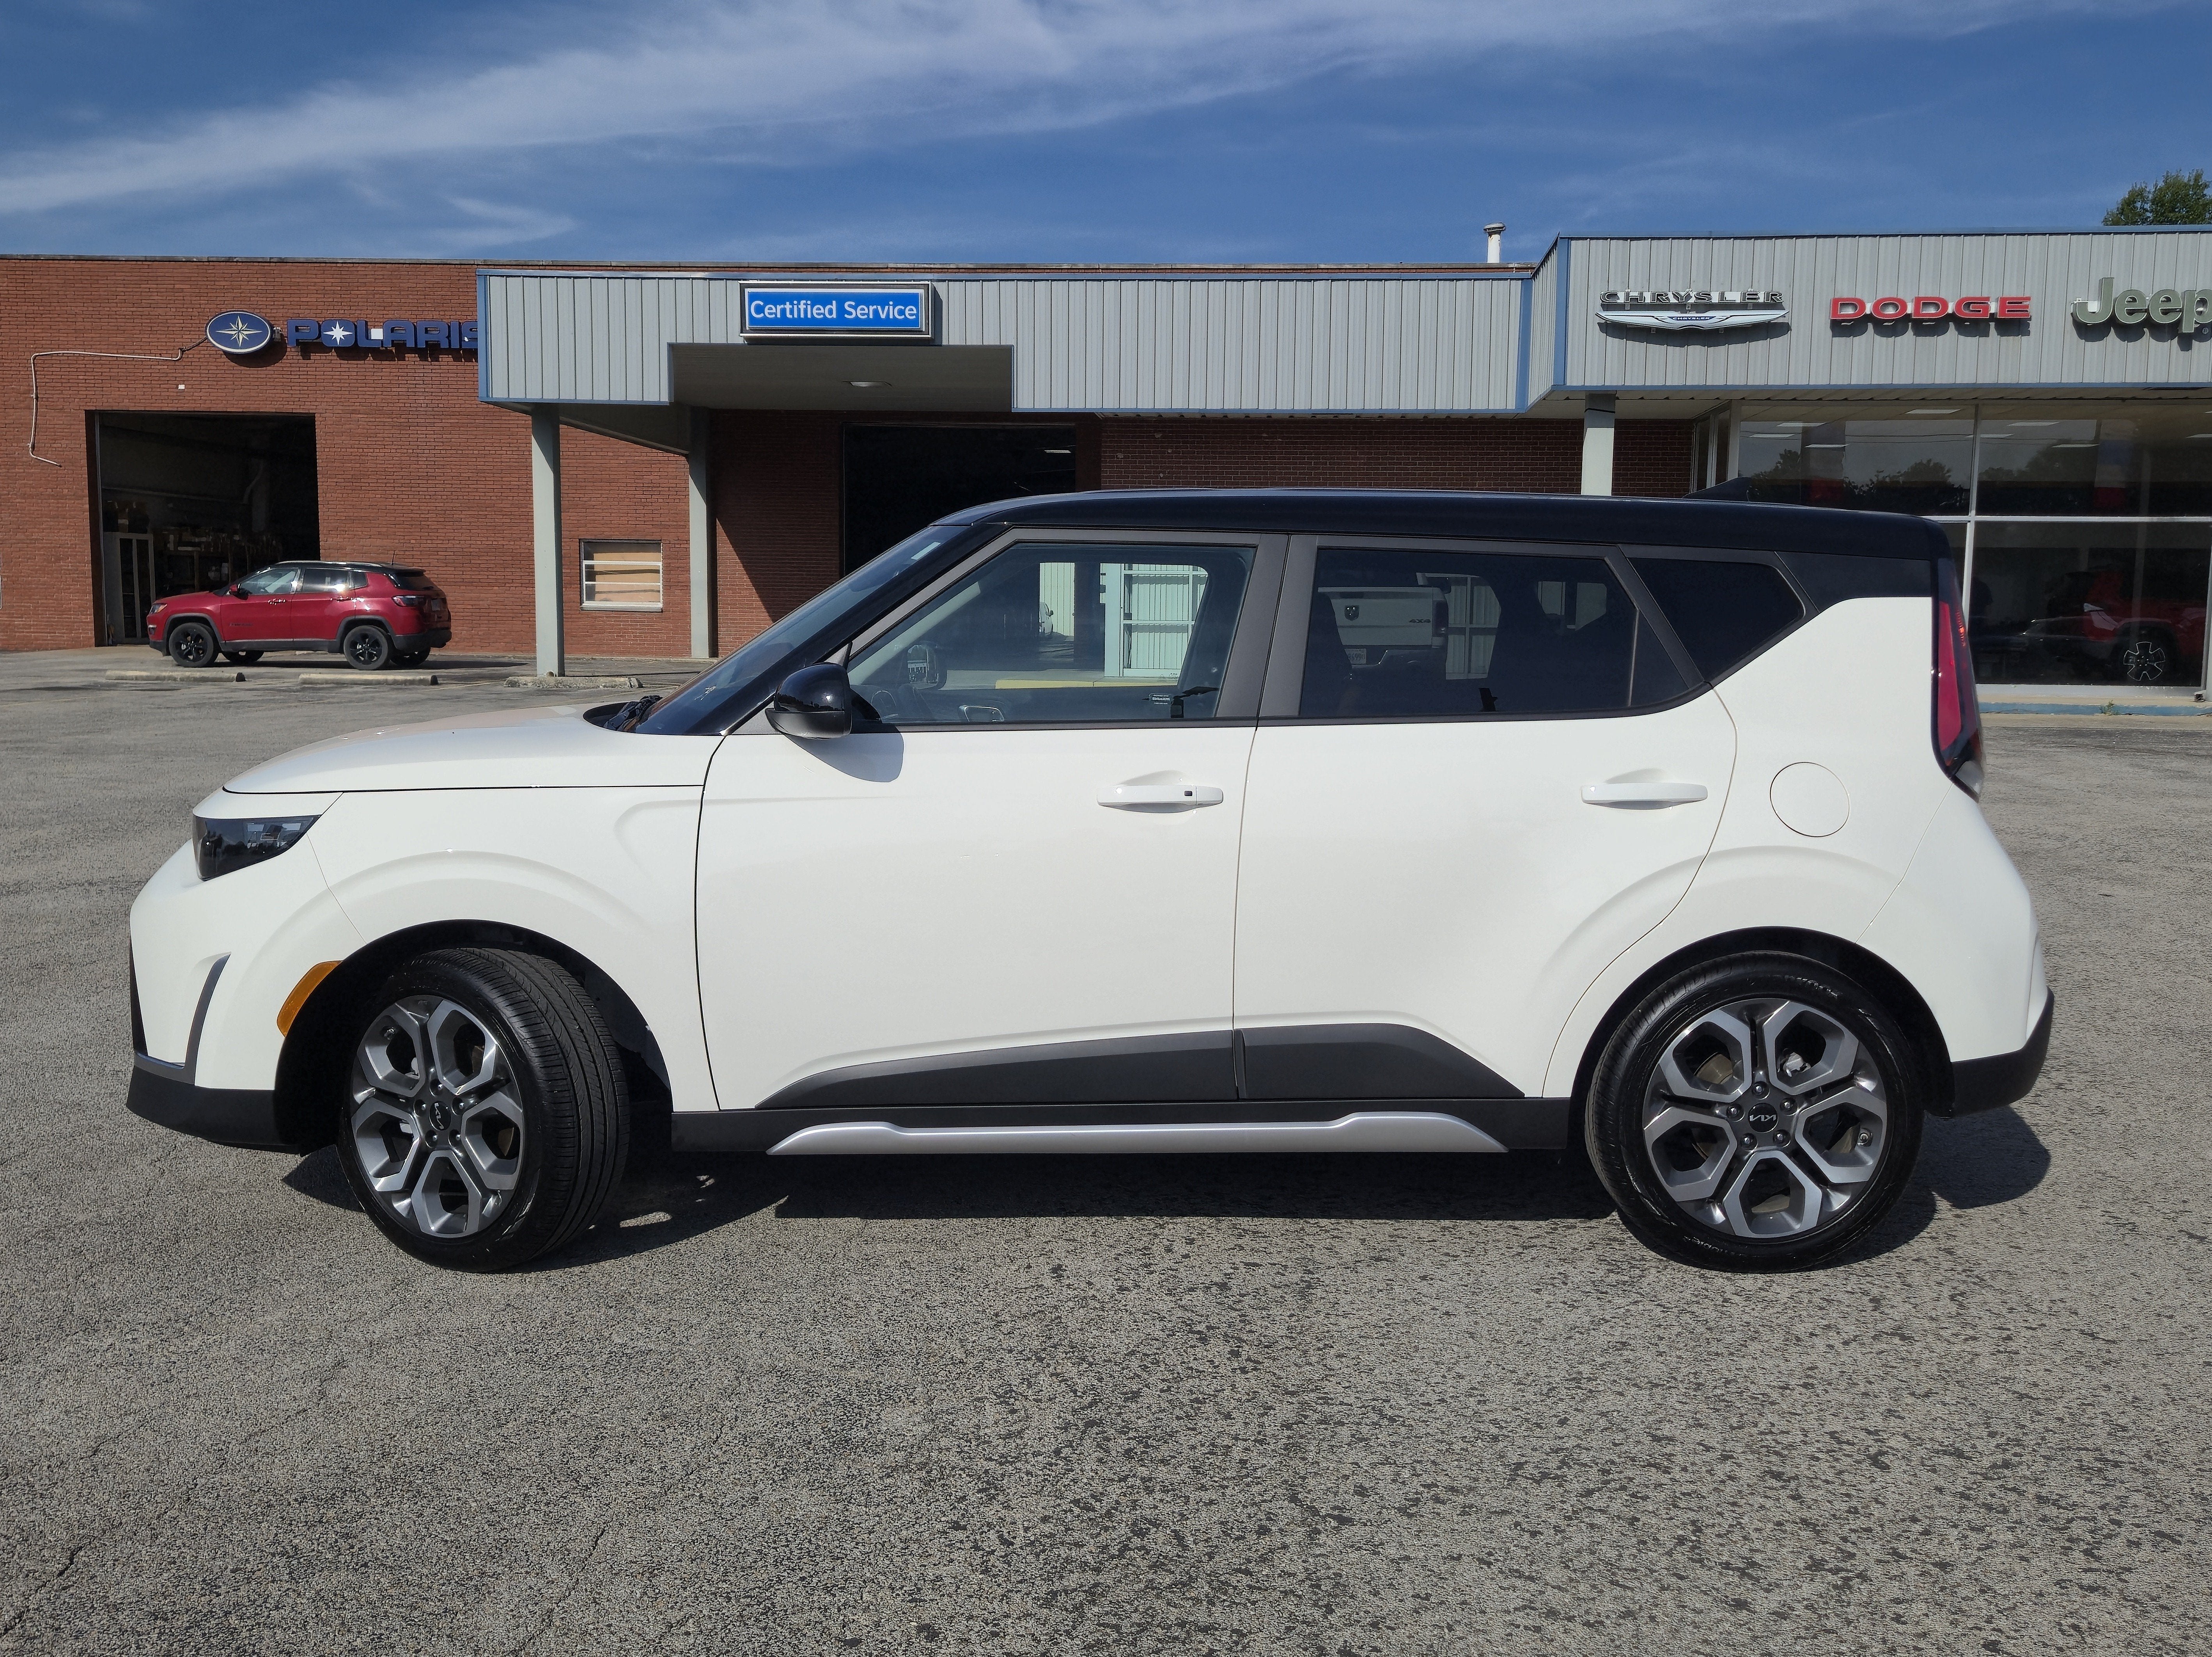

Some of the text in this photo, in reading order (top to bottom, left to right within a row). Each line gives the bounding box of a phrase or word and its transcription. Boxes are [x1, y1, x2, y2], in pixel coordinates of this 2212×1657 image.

[1600, 290, 1785, 303] CHRYSLER
[2074, 277, 2212, 333] Jeep
[750, 300, 917, 319] Certified Service
[1830, 296, 2031, 319] DODGE
